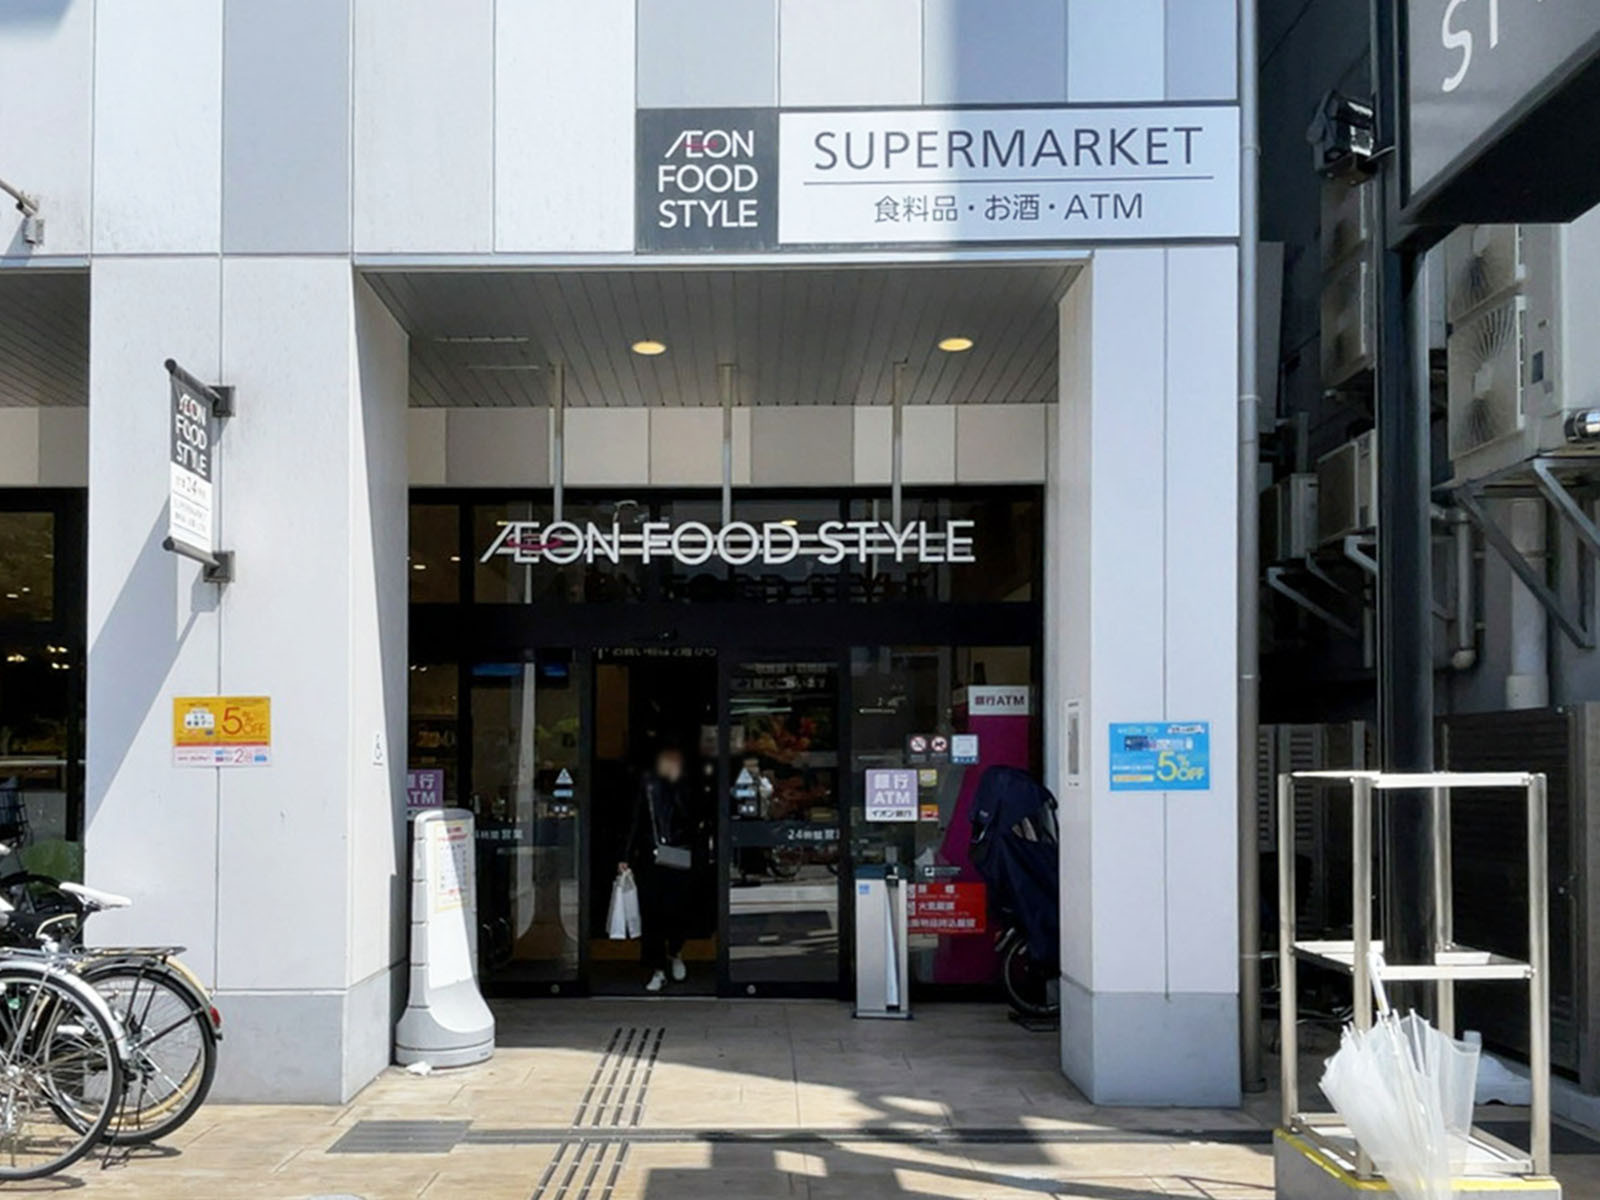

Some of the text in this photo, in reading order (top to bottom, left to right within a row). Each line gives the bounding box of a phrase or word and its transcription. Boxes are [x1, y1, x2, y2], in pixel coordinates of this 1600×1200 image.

[815, 126, 1203, 170] SUPERMARKET
[658, 165, 758, 193] FOOD
[658, 199, 758, 229] STYLE
[175, 414, 207, 450] FOOD
[176, 441, 207, 477] STYLE
[642, 521, 801, 565] FOOD
[817, 520, 976, 564] STYLE
[872, 791, 911, 805] ATM
